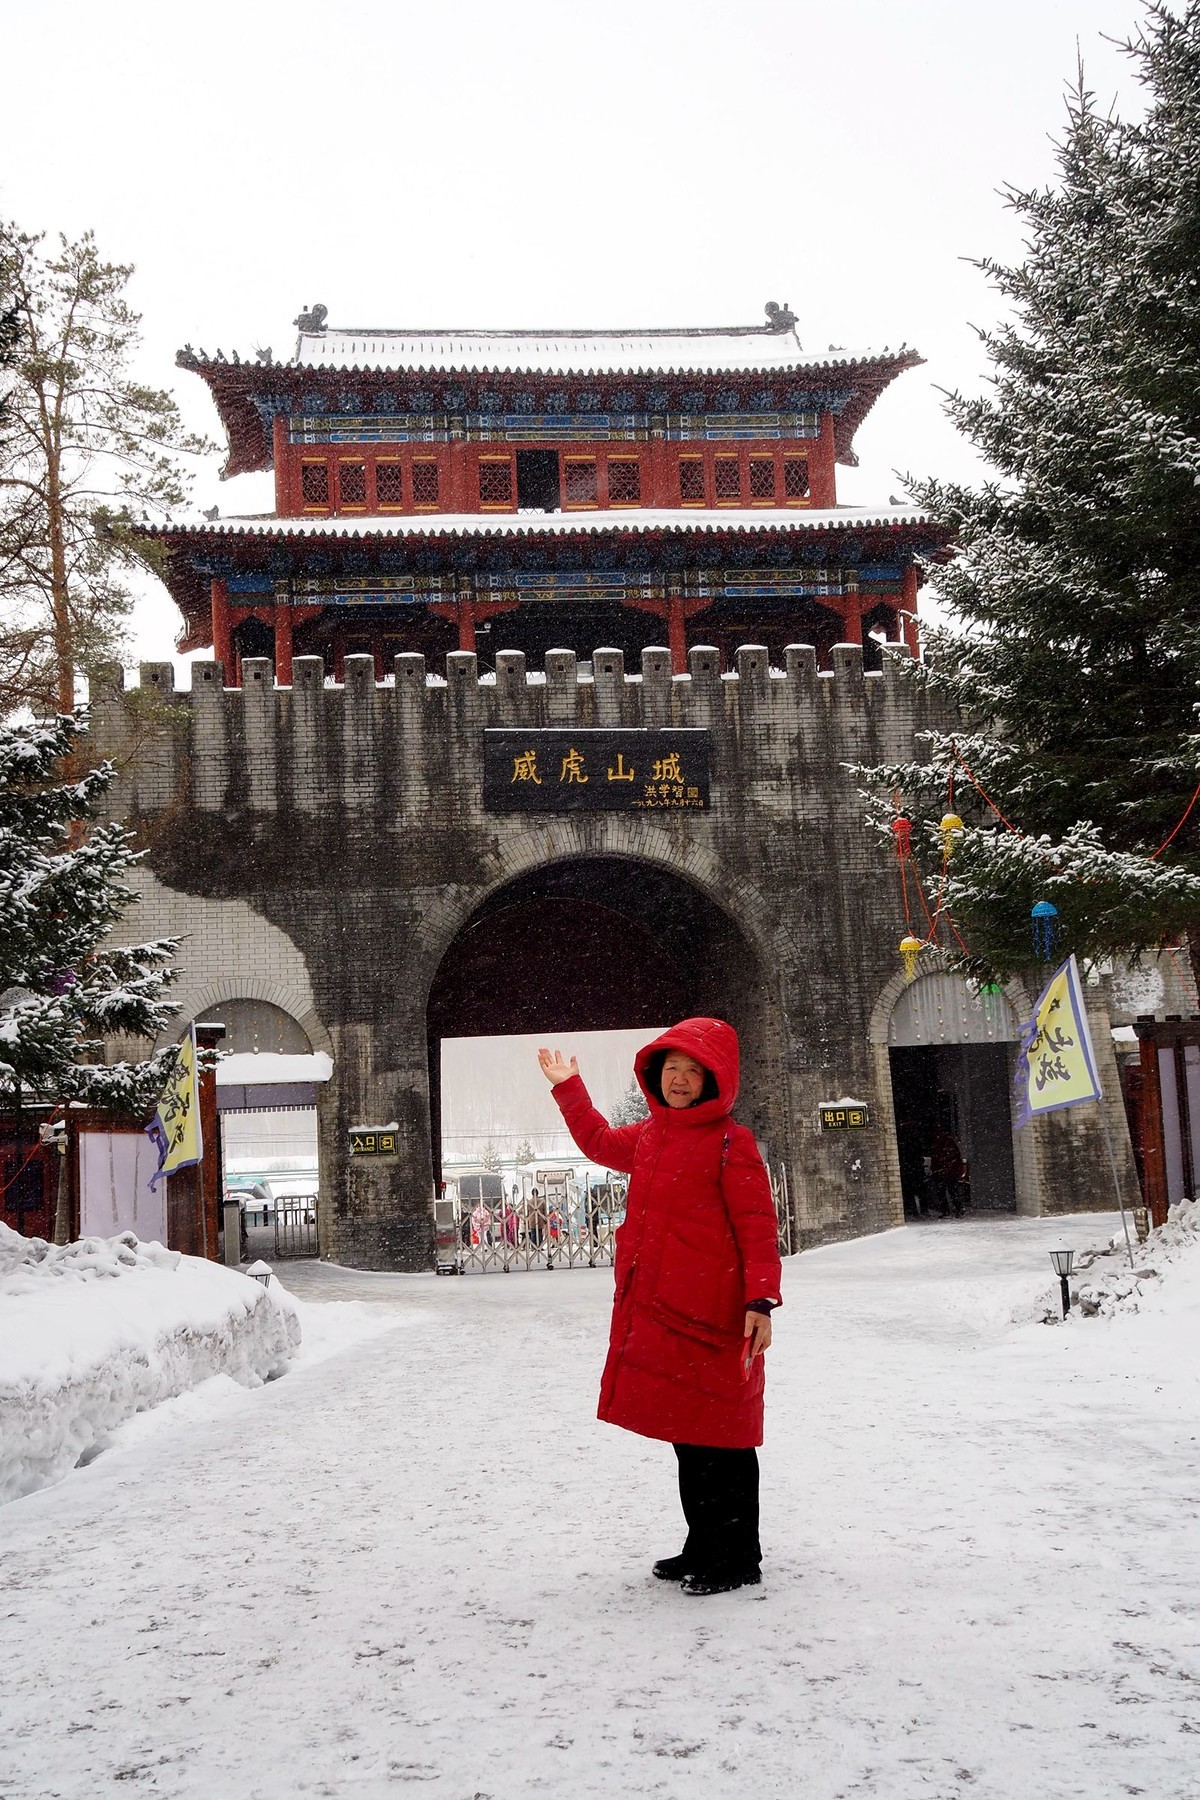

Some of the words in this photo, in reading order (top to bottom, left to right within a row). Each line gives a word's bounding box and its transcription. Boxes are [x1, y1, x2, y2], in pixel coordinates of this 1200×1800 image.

[511, 748, 685, 785] 威虎山城
[643, 784, 684, 798] 洪学智
[824, 1111, 845, 1122] 出口
[353, 1136, 375, 1147] 入口
